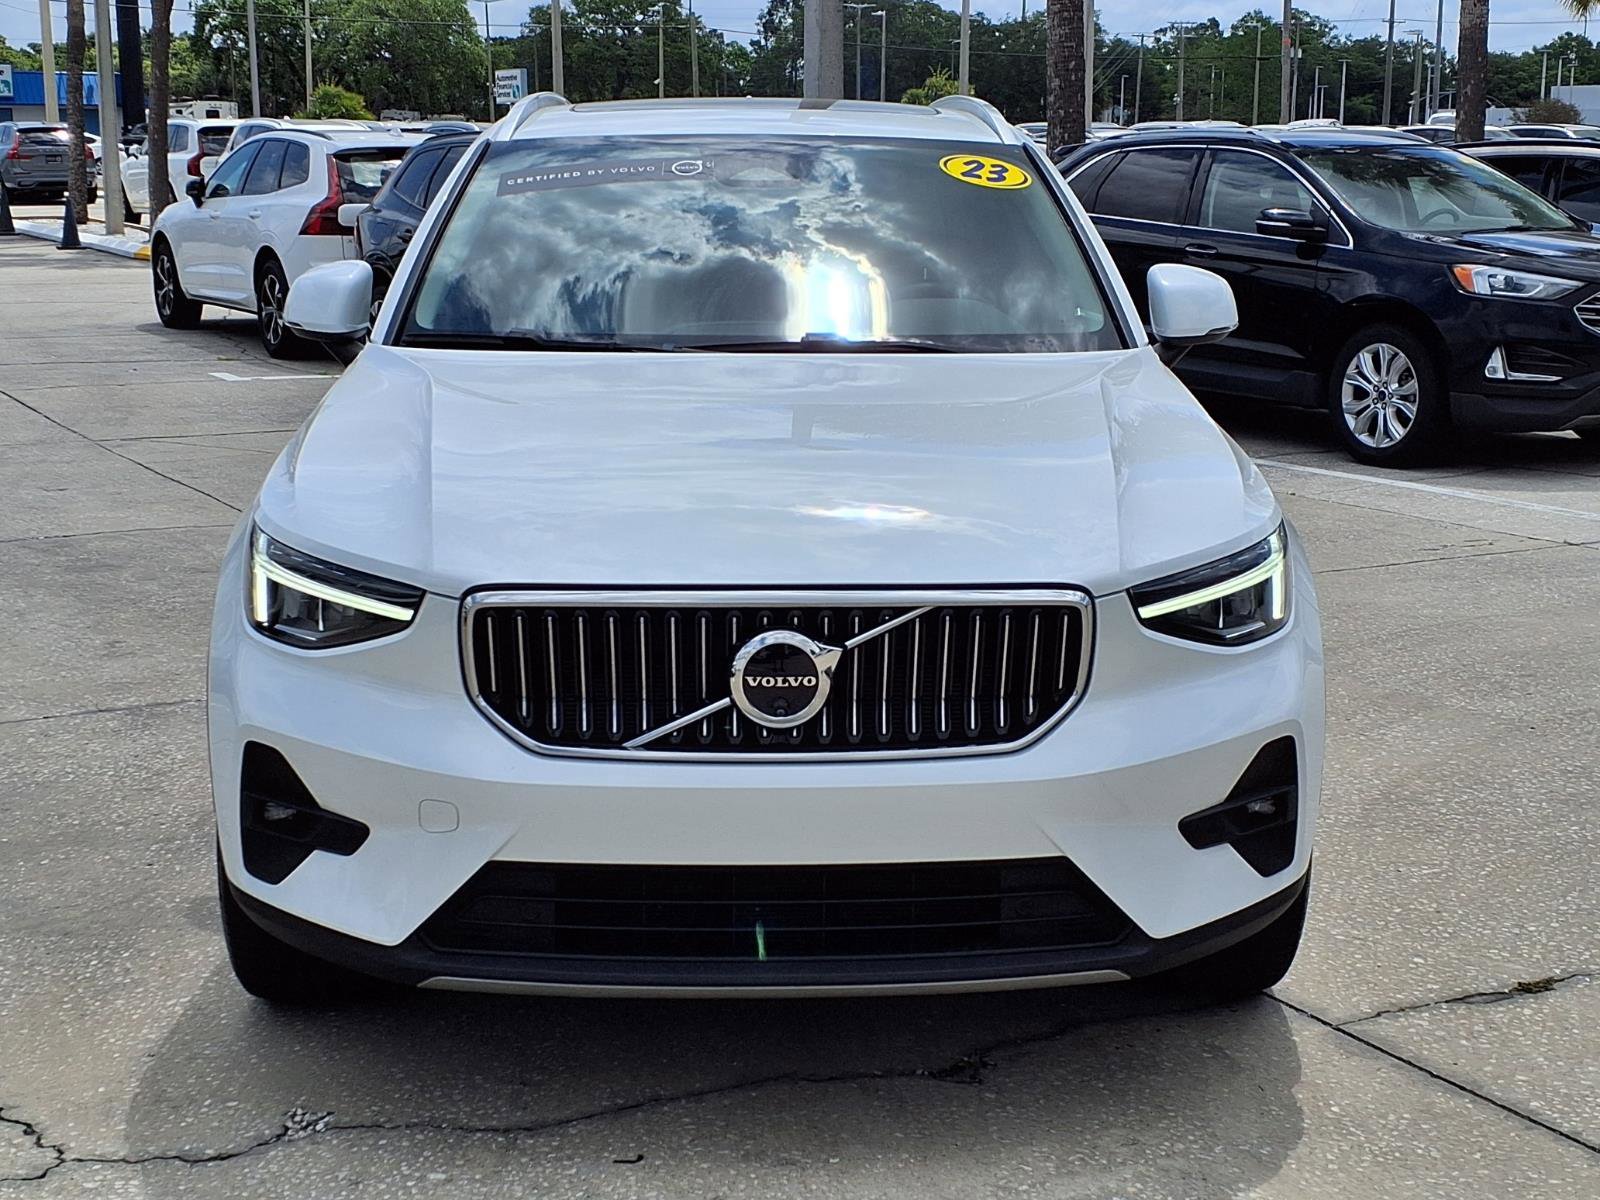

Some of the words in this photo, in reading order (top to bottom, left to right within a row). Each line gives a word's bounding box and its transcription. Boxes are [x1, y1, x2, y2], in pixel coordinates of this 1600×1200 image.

[507, 171, 581, 185] CERTIFIED
[611, 166, 655, 174] VOLVO
[960, 160, 1009, 183] 23
[744, 676, 817, 687] VOLVO
